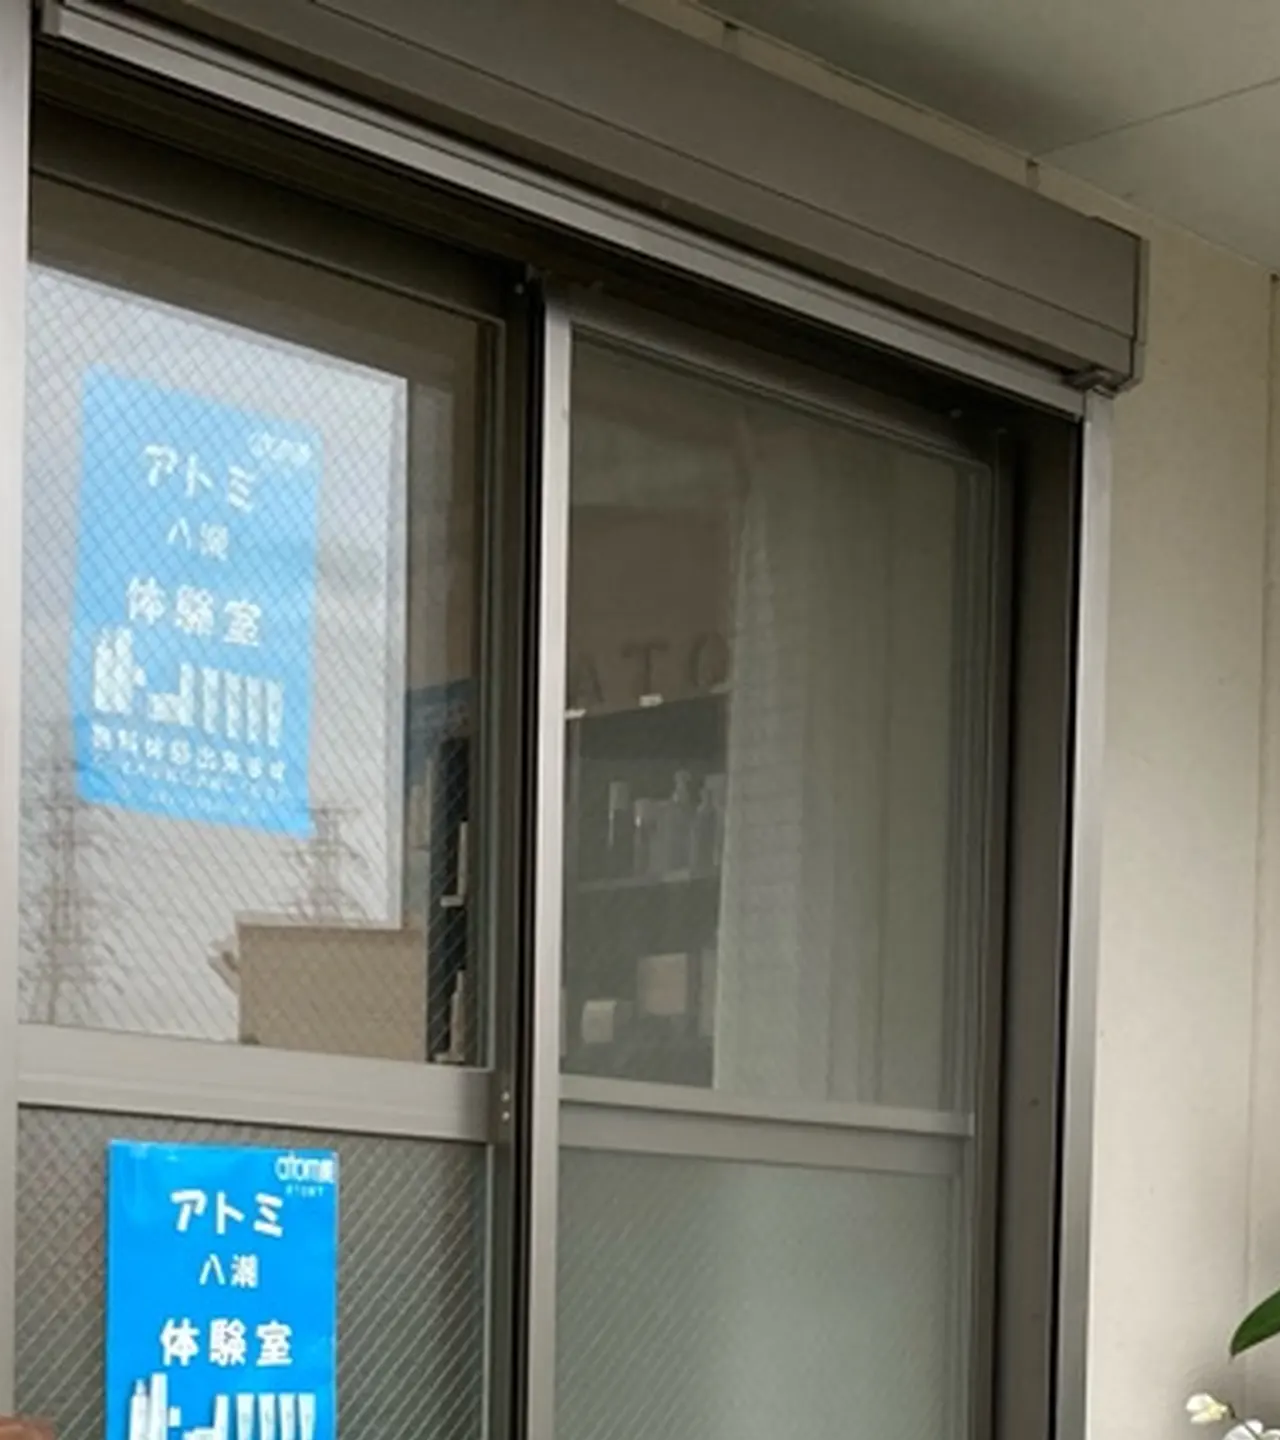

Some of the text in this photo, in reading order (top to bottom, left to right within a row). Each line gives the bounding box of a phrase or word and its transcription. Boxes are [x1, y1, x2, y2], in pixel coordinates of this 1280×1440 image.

[143, 442, 257, 514] アトミ
[170, 1189, 284, 1237] アトミ
[160, 1318, 293, 1367] 体験室
